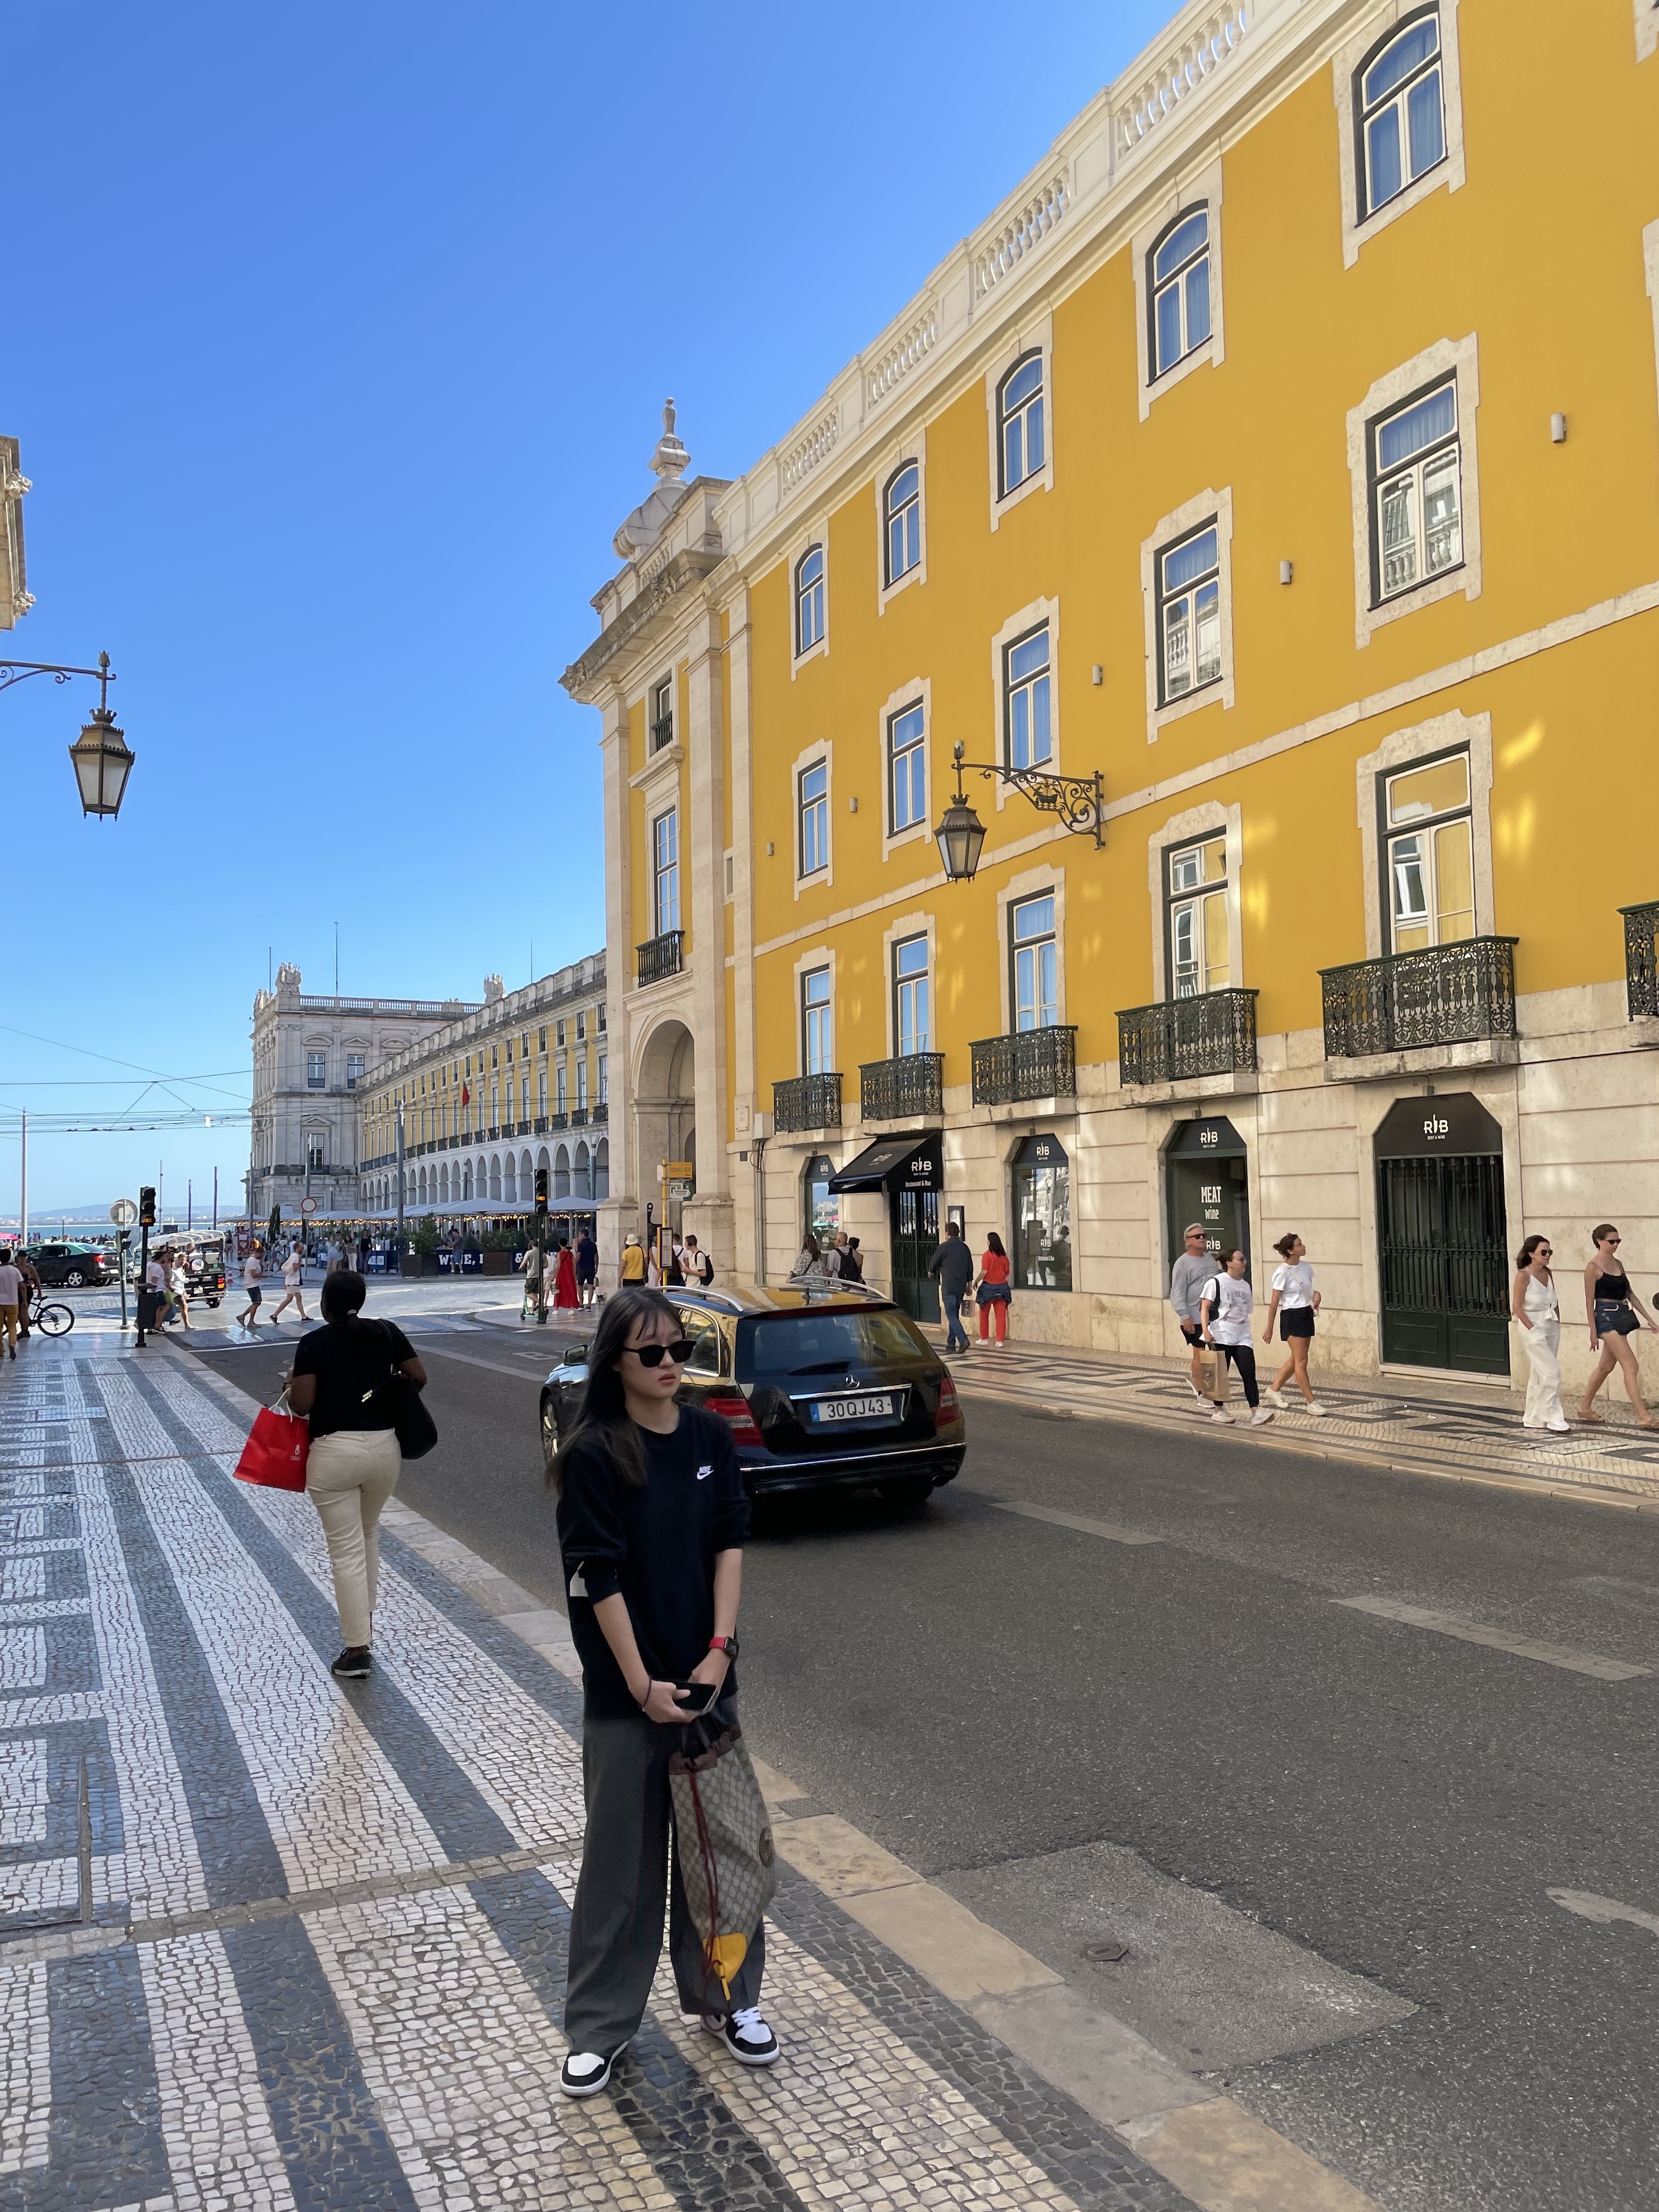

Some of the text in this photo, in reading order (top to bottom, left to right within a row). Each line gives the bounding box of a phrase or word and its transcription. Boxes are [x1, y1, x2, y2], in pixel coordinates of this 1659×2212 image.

[1424, 1114, 1449, 1134] RIB
[1200, 1127, 1218, 1143] RIB
[1036, 1142, 1049, 1156] RIB
[911, 1156, 932, 1172] RIB
[1200, 1186, 1222, 1203] MEAT
[1204, 1205, 1220, 1220] wine
[1206, 1236, 1221, 1250] RIB
[827, 1399, 884, 1418] 30QJ43
